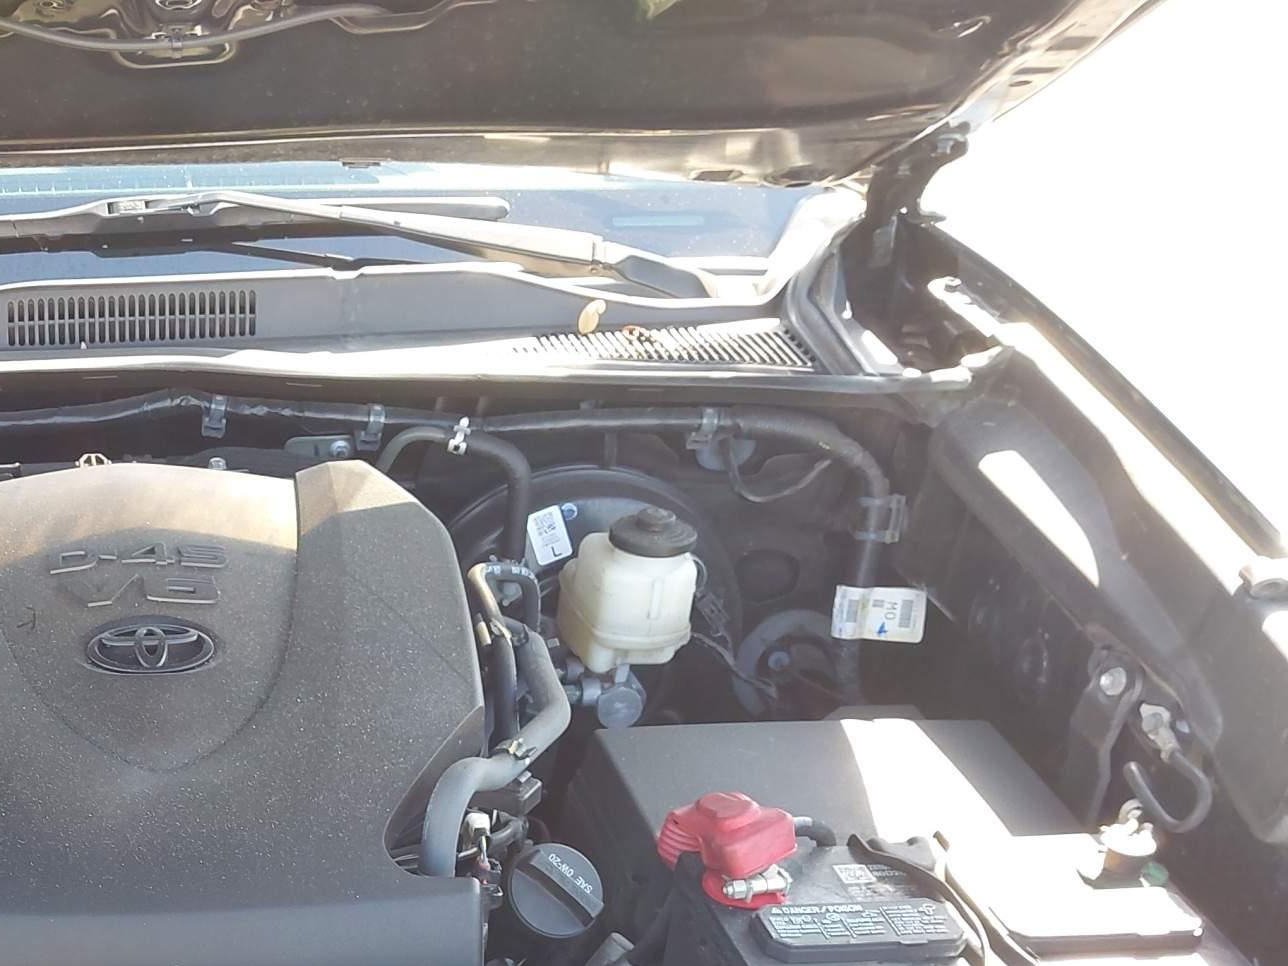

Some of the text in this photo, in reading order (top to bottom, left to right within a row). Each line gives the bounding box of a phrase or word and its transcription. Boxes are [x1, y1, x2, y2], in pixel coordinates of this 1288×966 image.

[49, 541, 230, 575] D-4S
[56, 573, 221, 609] V6
[575, 875, 593, 894] SAE
